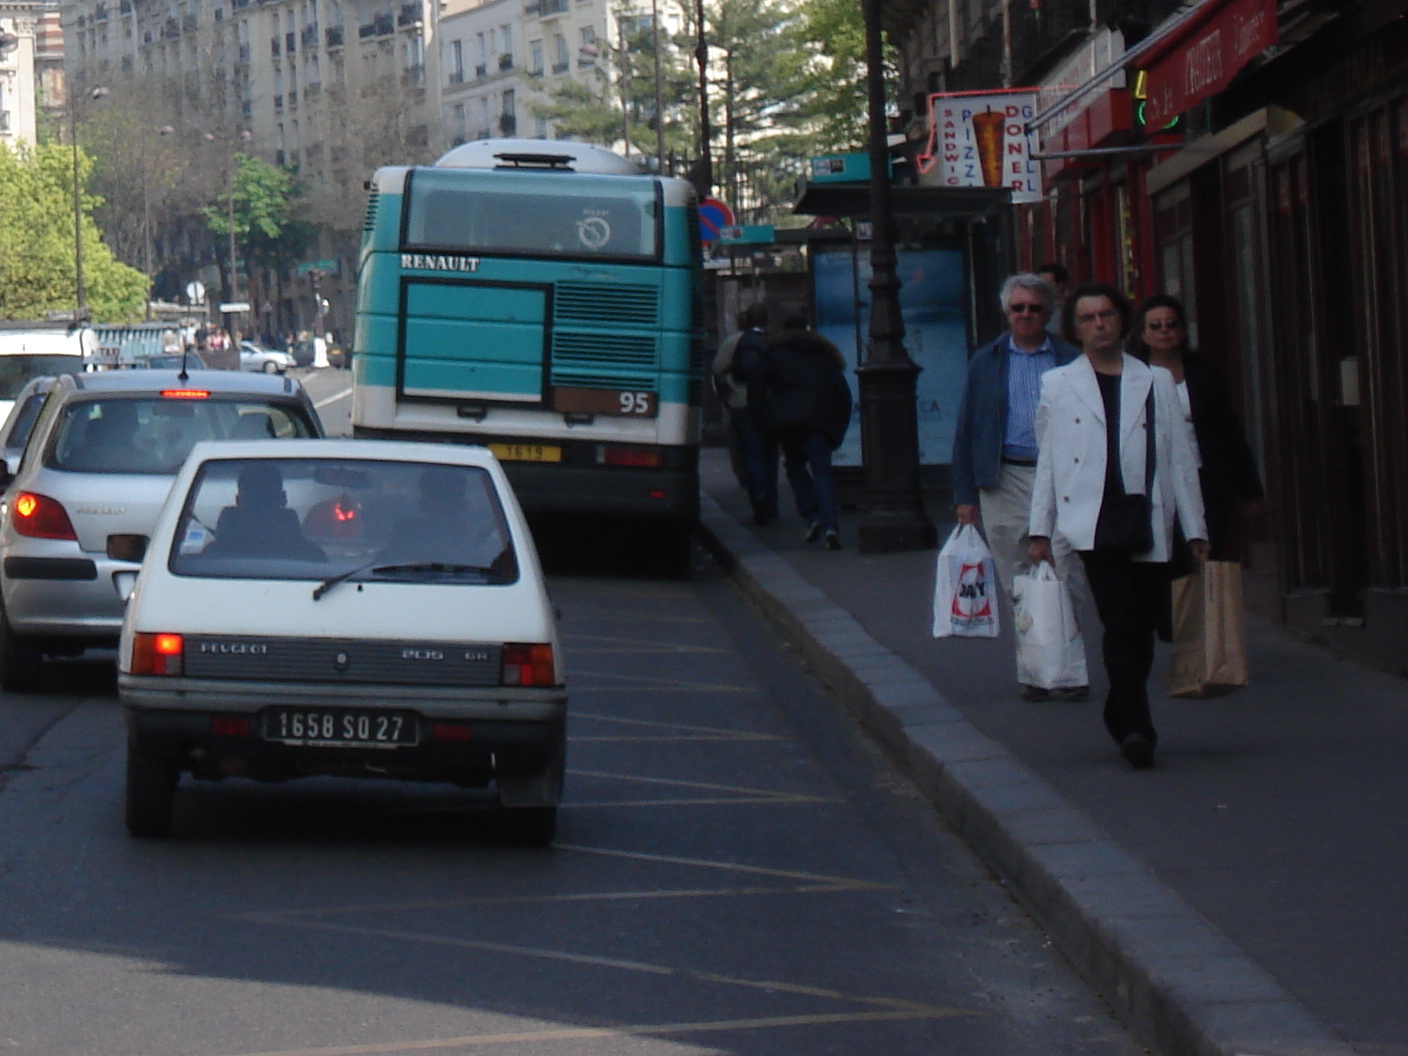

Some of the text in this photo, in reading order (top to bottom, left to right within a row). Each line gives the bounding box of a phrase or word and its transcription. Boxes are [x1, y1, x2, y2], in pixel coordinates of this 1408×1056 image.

[943, 109, 959, 185] SANDWIC
[961, 109, 975, 187] PIZZ
[401, 254, 480, 272] RENAULT
[618, 391, 649, 414] 95
[200, 643, 268, 655] PEUGEOT
[402, 649, 444, 661] 205
[279, 712, 334, 738] 1658
[376, 717, 404, 741] 27
